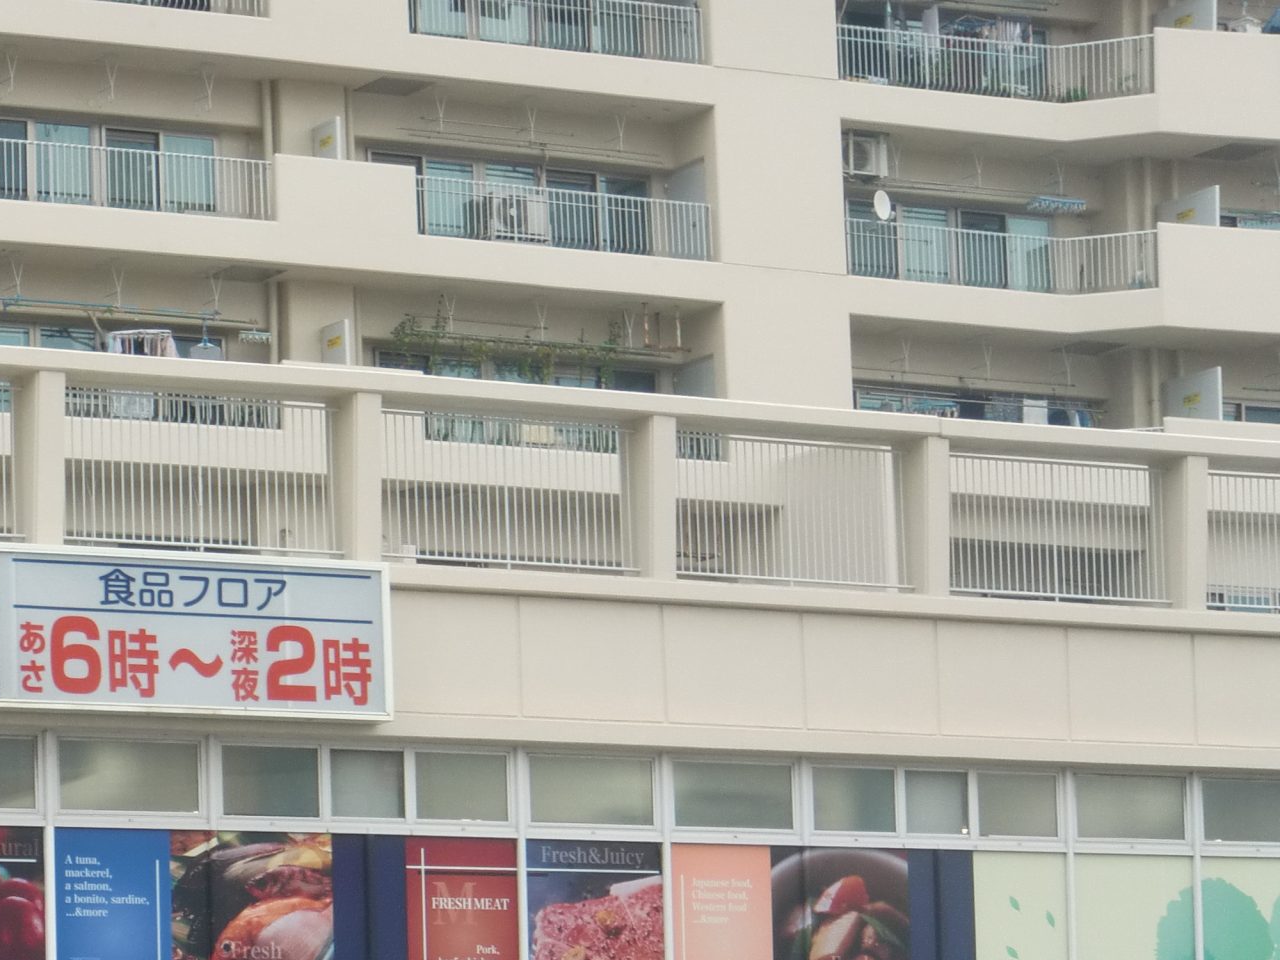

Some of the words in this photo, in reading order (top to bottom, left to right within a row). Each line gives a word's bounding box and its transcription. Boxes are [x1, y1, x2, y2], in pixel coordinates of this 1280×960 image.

[99, 568, 287, 611] 食品フロア
[65, 867, 113, 880] mackerel,
[431, 897, 472, 910] FRESH
[473, 898, 510, 910] MEAT
[231, 942, 283, 960] Fresh
